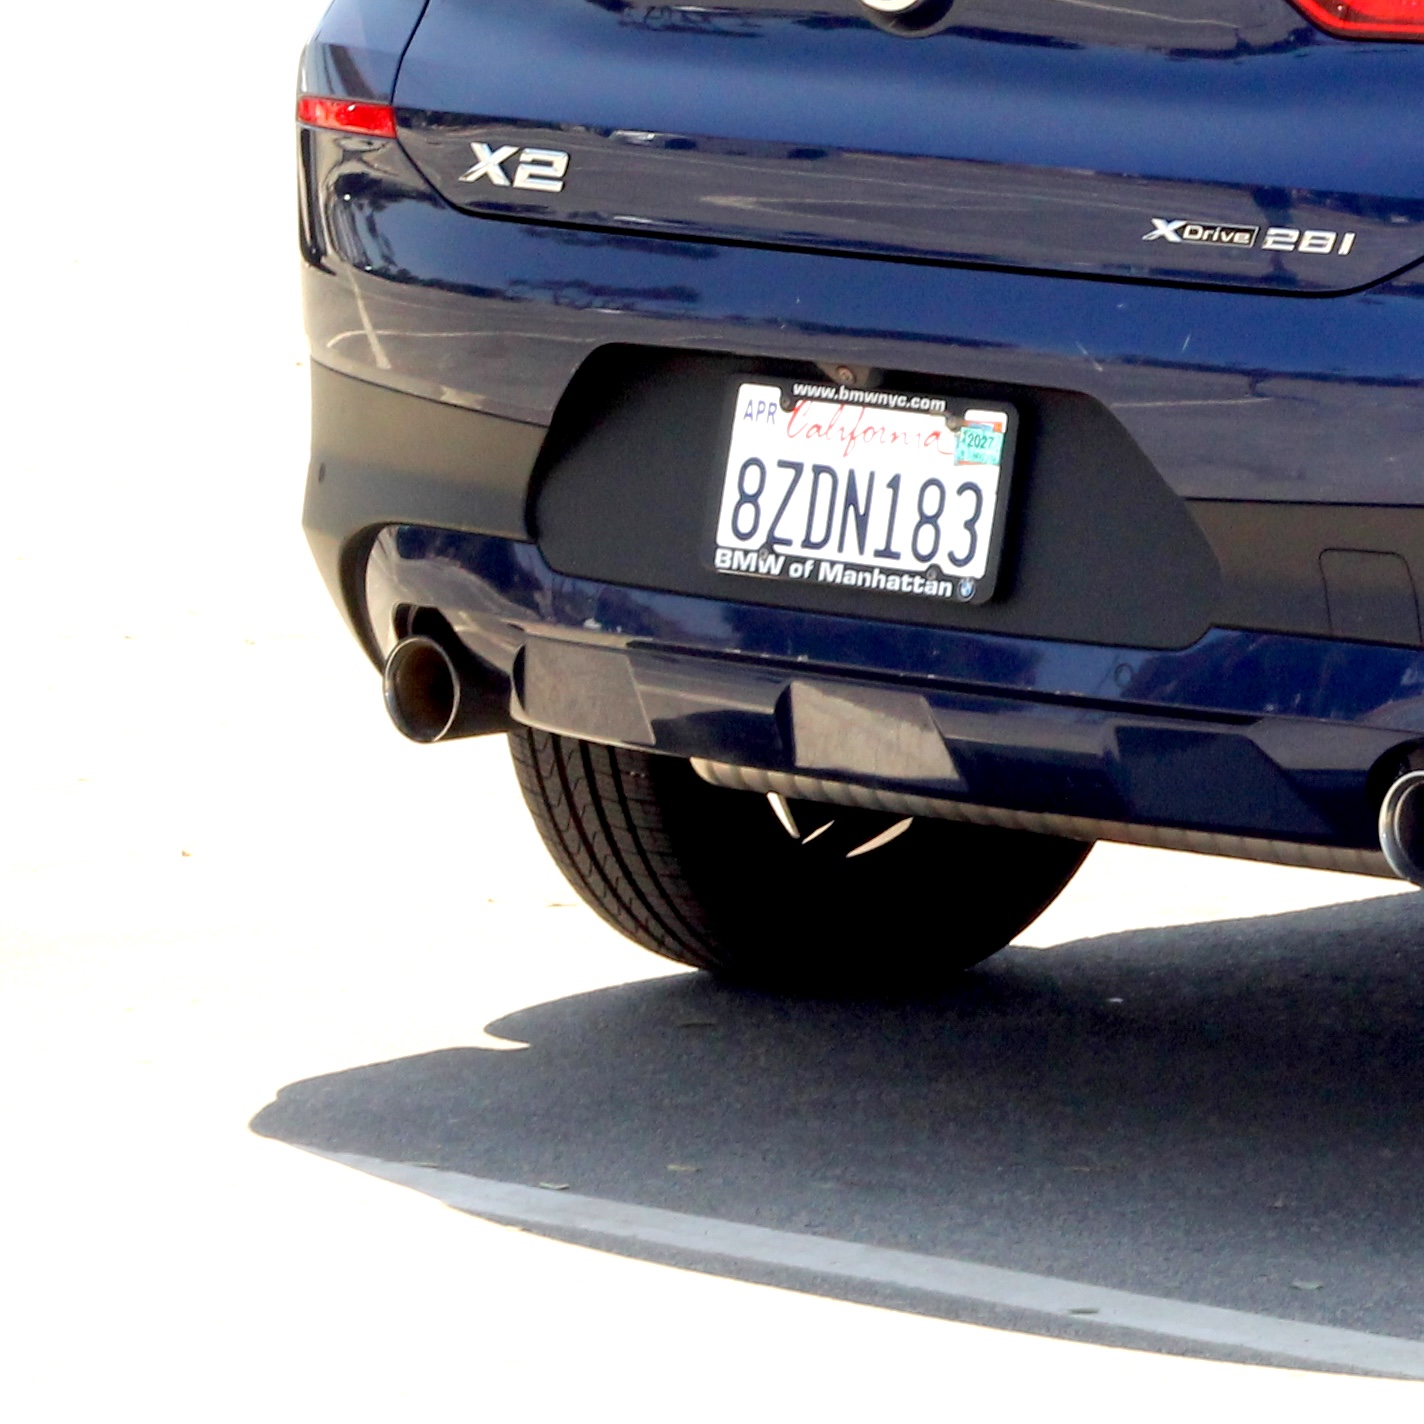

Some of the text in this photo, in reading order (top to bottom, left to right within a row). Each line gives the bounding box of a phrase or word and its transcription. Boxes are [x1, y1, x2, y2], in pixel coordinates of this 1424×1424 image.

[460, 142, 569, 193] X2
[743, 399, 777, 424] APR
[793, 383, 946, 412] www.bmwnyc.com
[786, 399, 955, 457] California
[967, 432, 995, 450] 2027
[731, 457, 983, 568] 8ZDN183
[715, 548, 953, 598] BMW of Manhattan
